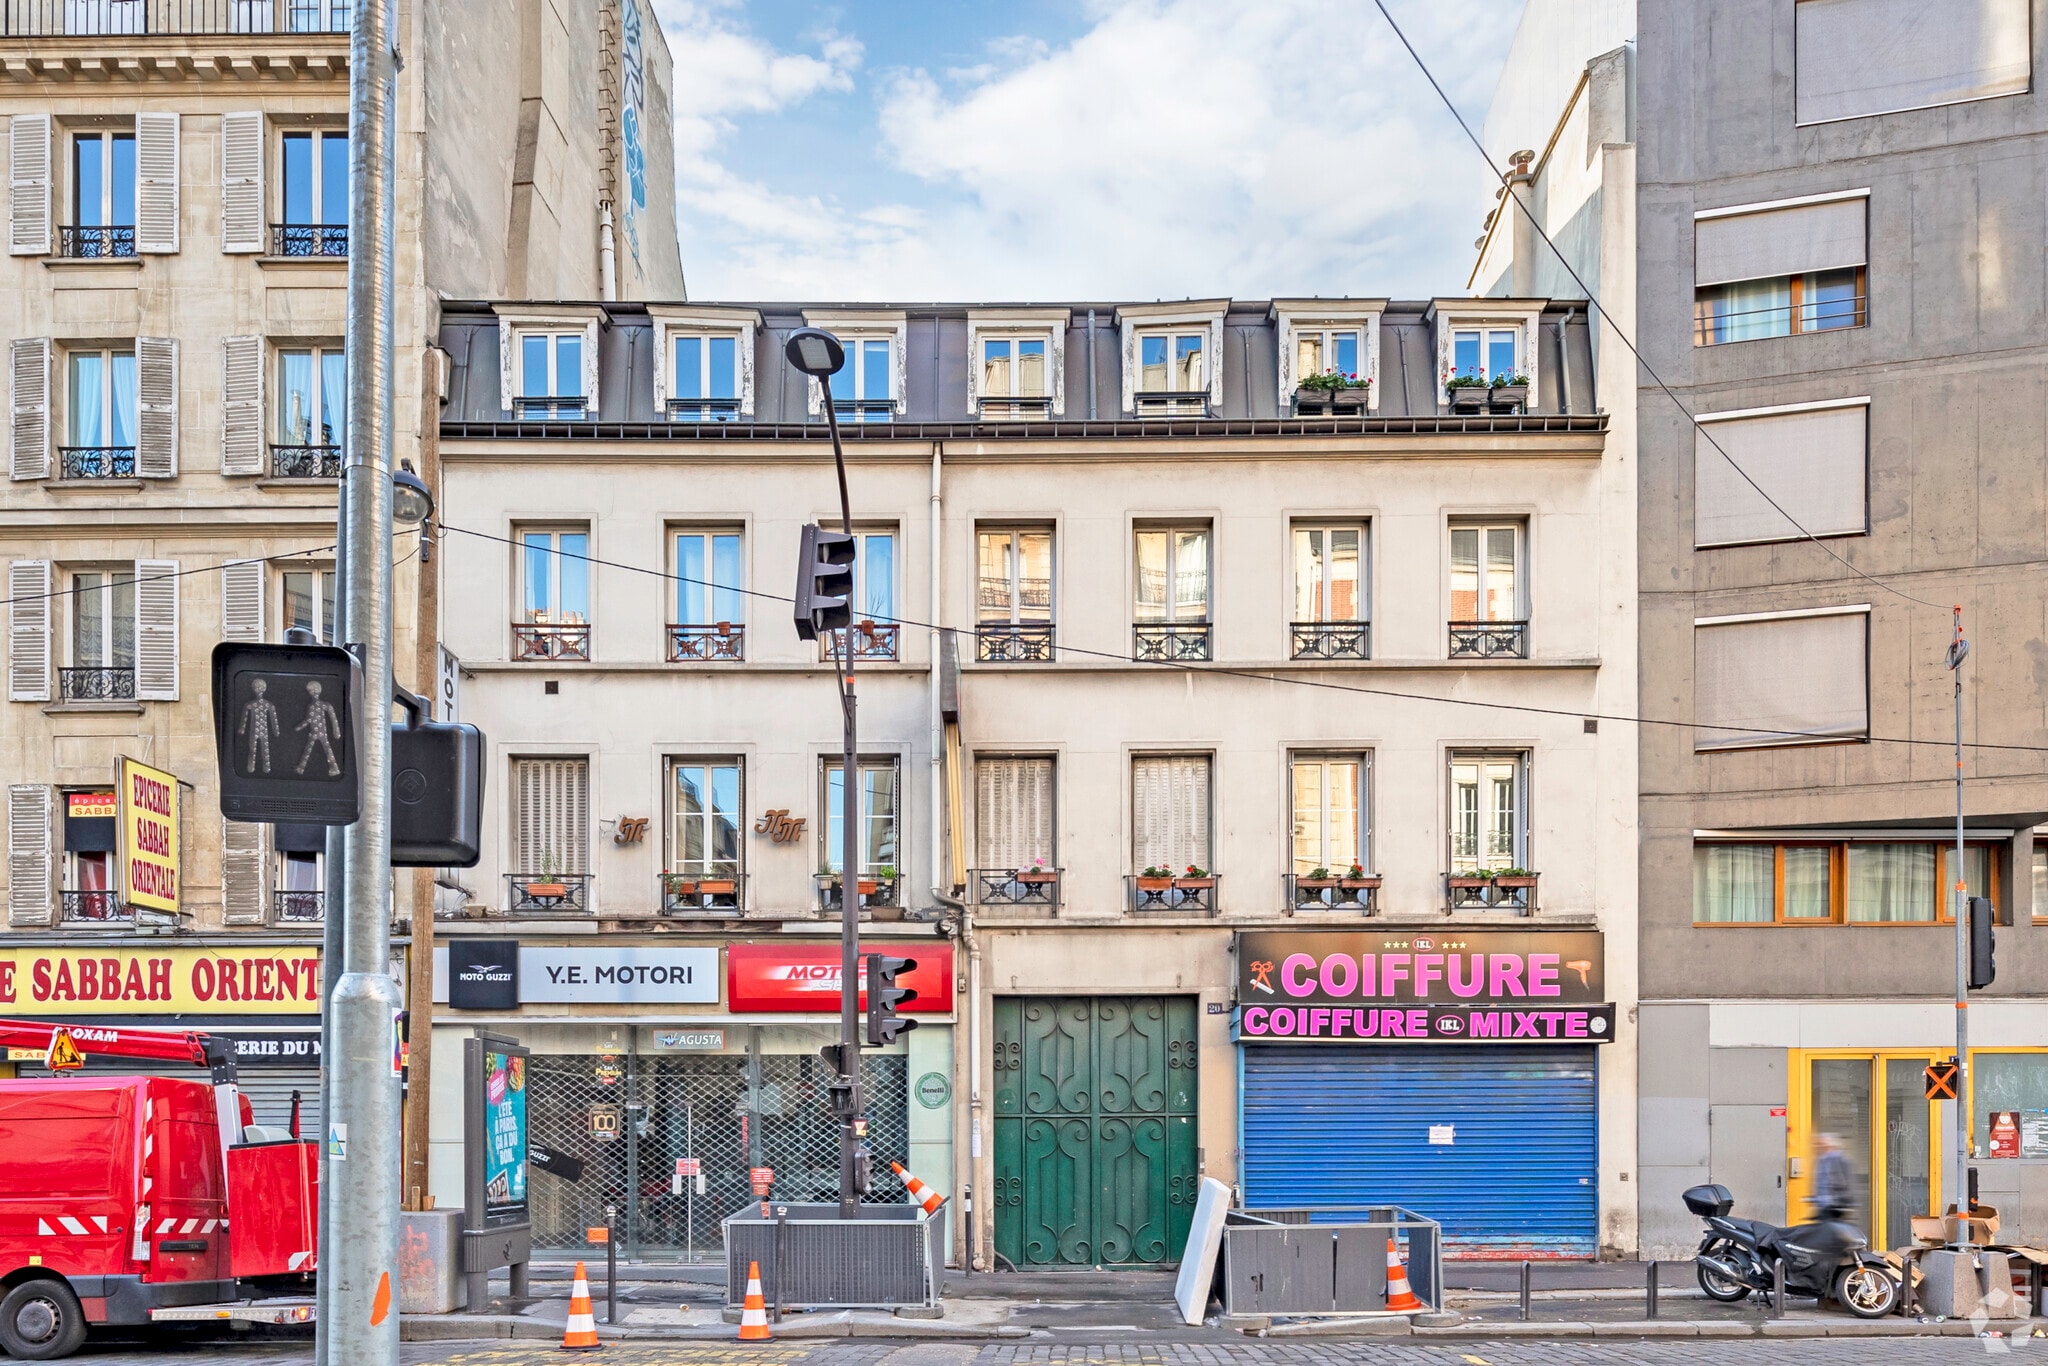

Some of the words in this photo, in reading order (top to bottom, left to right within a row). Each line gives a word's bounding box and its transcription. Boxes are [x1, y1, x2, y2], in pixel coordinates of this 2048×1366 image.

[74, 796, 116, 806] épice
[133, 773, 171, 818] EPICERIE
[75, 807, 116, 815] SABB
[137, 816, 169, 858] SABBAH
[131, 857, 175, 901] ORIENTALE
[1416, 940, 1431, 949] IKL
[32, 957, 173, 1001] SABBAH
[460, 973, 483, 981] MOTO
[486, 973, 511, 981] GUZZI
[546, 965, 588, 984] Y.E.
[595, 965, 692, 984] MOTORI
[1281, 953, 1560, 997] COIFFURE
[1208, 1004, 1220, 1013] 20
[1244, 1006, 1428, 1037] COIFFURE
[1440, 1019, 1460, 1031] IKL
[1470, 1011, 1588, 1037] MIXTE
[66, 1027, 118, 1043] OXAM
[678, 1035, 722, 1045] AGUSTA
[282, 1041, 309, 1055] DU
[593, 1114, 616, 1131] 100
